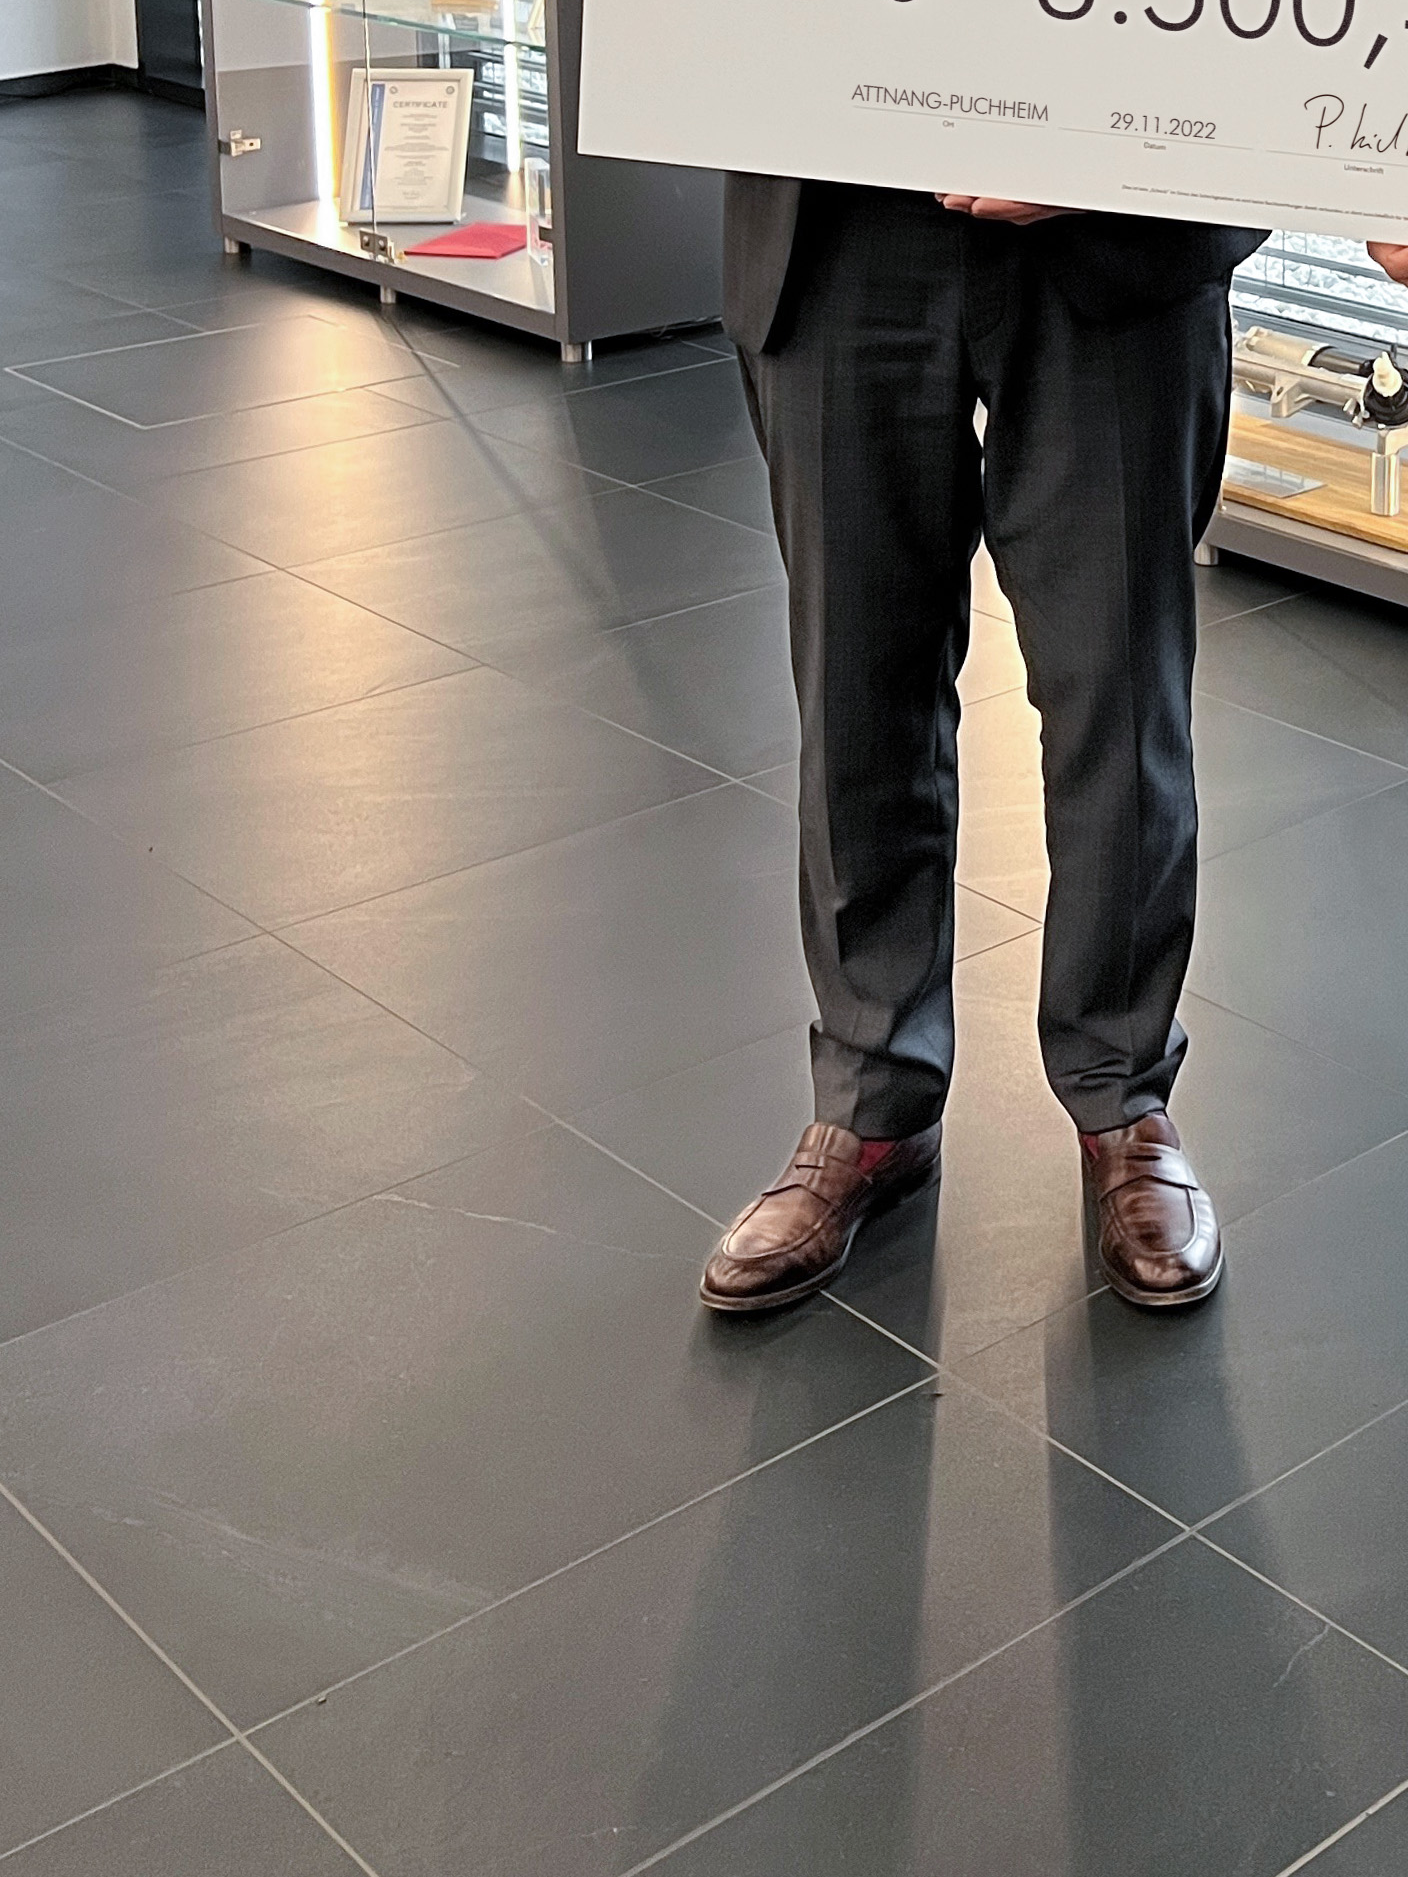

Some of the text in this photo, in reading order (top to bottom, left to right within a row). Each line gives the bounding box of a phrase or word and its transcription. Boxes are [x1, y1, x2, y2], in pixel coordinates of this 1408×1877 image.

[392, 100, 448, 109] CERTIFICATE
[851, 84, 1049, 122] ATTNANG-PUCHHEIM
[1110, 111, 1217, 140] 29.11.2022
